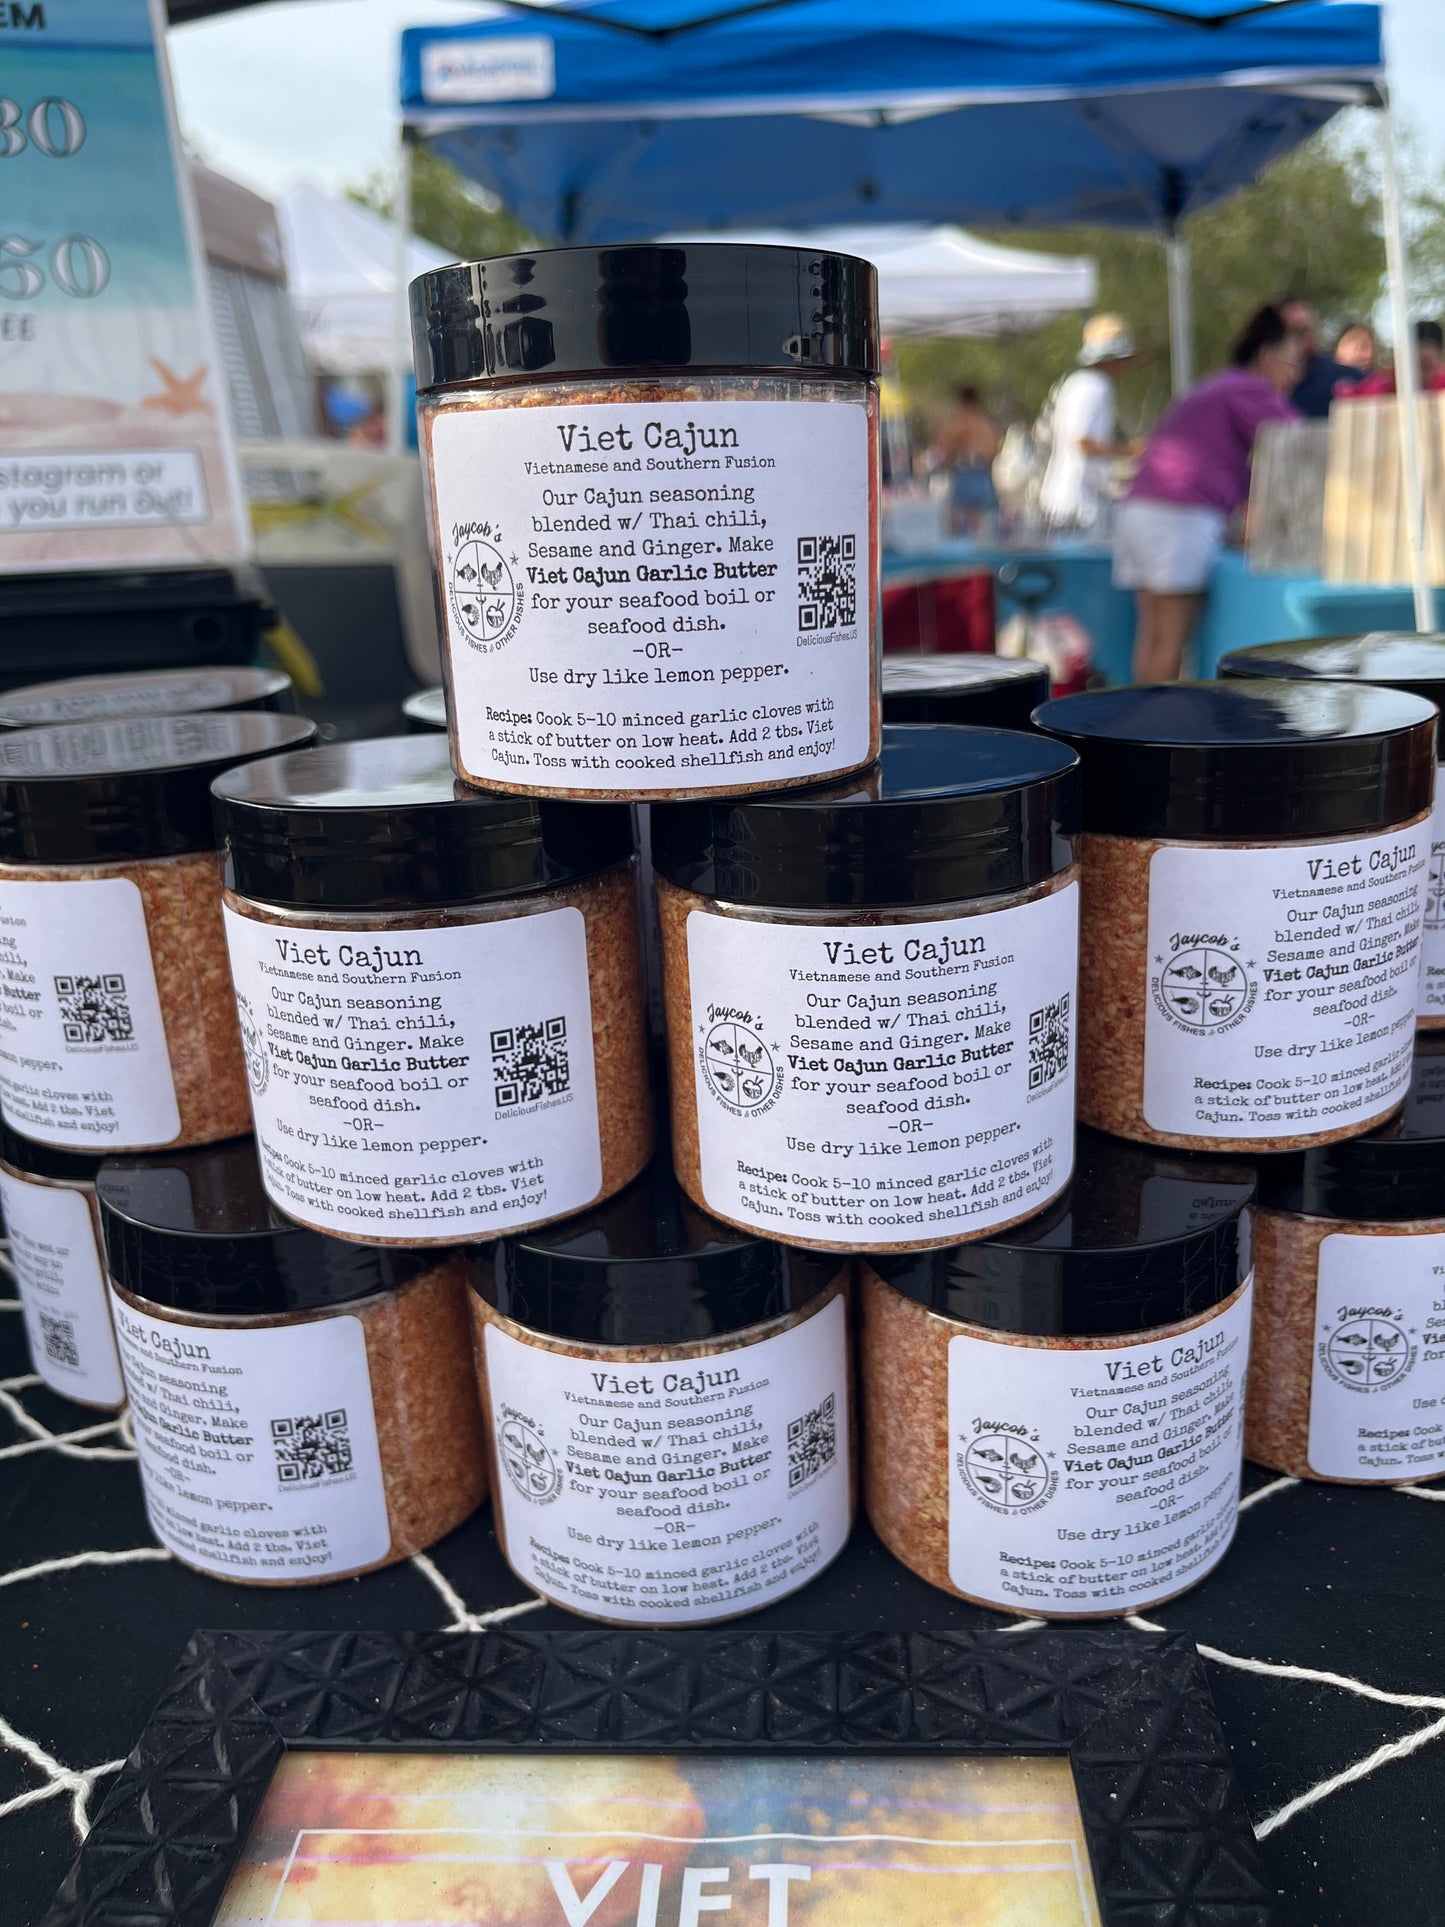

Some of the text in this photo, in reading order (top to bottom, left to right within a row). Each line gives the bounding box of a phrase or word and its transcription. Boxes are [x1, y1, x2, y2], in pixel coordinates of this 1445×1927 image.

[557, 423, 739, 456] Viet Cajun
[524, 456, 775, 475] Vietnamese and Southern Fusion
[543, 484, 755, 509] Our Cajun seasoning
[452, 521, 502, 547] Jaycob's
[531, 510, 766, 532] blended w/ Thai chili,
[528, 536, 773, 559] Sesame and Ginger. Make
[526, 561, 778, 588] Viet Cajun Garlic Butter
[531, 587, 776, 613] for your seafood boil or
[449, 582, 525, 654] DELICIOUS FISHES OTHER DISHES
[588, 615, 725, 634] seafood dish.
[633, 642, 683, 659] -OR-
[529, 664, 789, 688] Use dry like lemon pepper.
[486, 697, 834, 728] Recipe: Cook 5-10 minced garlic cloves with
[489, 718, 833, 748] a stick of butter on low heat. Add 2 tbs. Viet
[492, 738, 835, 769] Cajun. Toss with cooked shellfish and enjoy!
[1306, 844, 1415, 880] Viet Cajun
[1287, 904, 1364, 922] Our Cajun
[275, 939, 424, 973] Viet Cajun
[823, 936, 986, 965] Viet Cajun
[259, 960, 462, 984] Vietnamese and Southern Fusion
[789, 955, 1014, 982] Vietnamese and Southern Fusion
[272, 986, 442, 1010] Our Cajun seasoning
[807, 982, 998, 1012] Our Cajun seasoning
[1151, 977, 1258, 1036] DELICIOUS FISHES OTHER DISHES
[267, 1004, 455, 1031] blended w/ Thai chili,
[795, 1000, 1006, 1030] blended w/ Thai chili,
[267, 1041, 470, 1072] Viet Cajun Garlic Butter
[786, 1038, 1014, 1076] Viet Cajun Garlic Butter
[1193, 1077, 1252, 1092] Recipe:
[1256, 1078, 1291, 1089] Cook
[151, 1332, 211, 1361] Cajun
[1104, 1331, 1226, 1381] Viet Cajun
[591, 1368, 742, 1395] Viet Cajun
[579, 1405, 753, 1433] Our Cajun seasoning
[1063, 1434, 1202, 1472] Viet Cajun Garlic
[565, 1451, 772, 1485] Viet Cajun Garlic Butter
[1060, 1560, 1096, 1570] Cook
